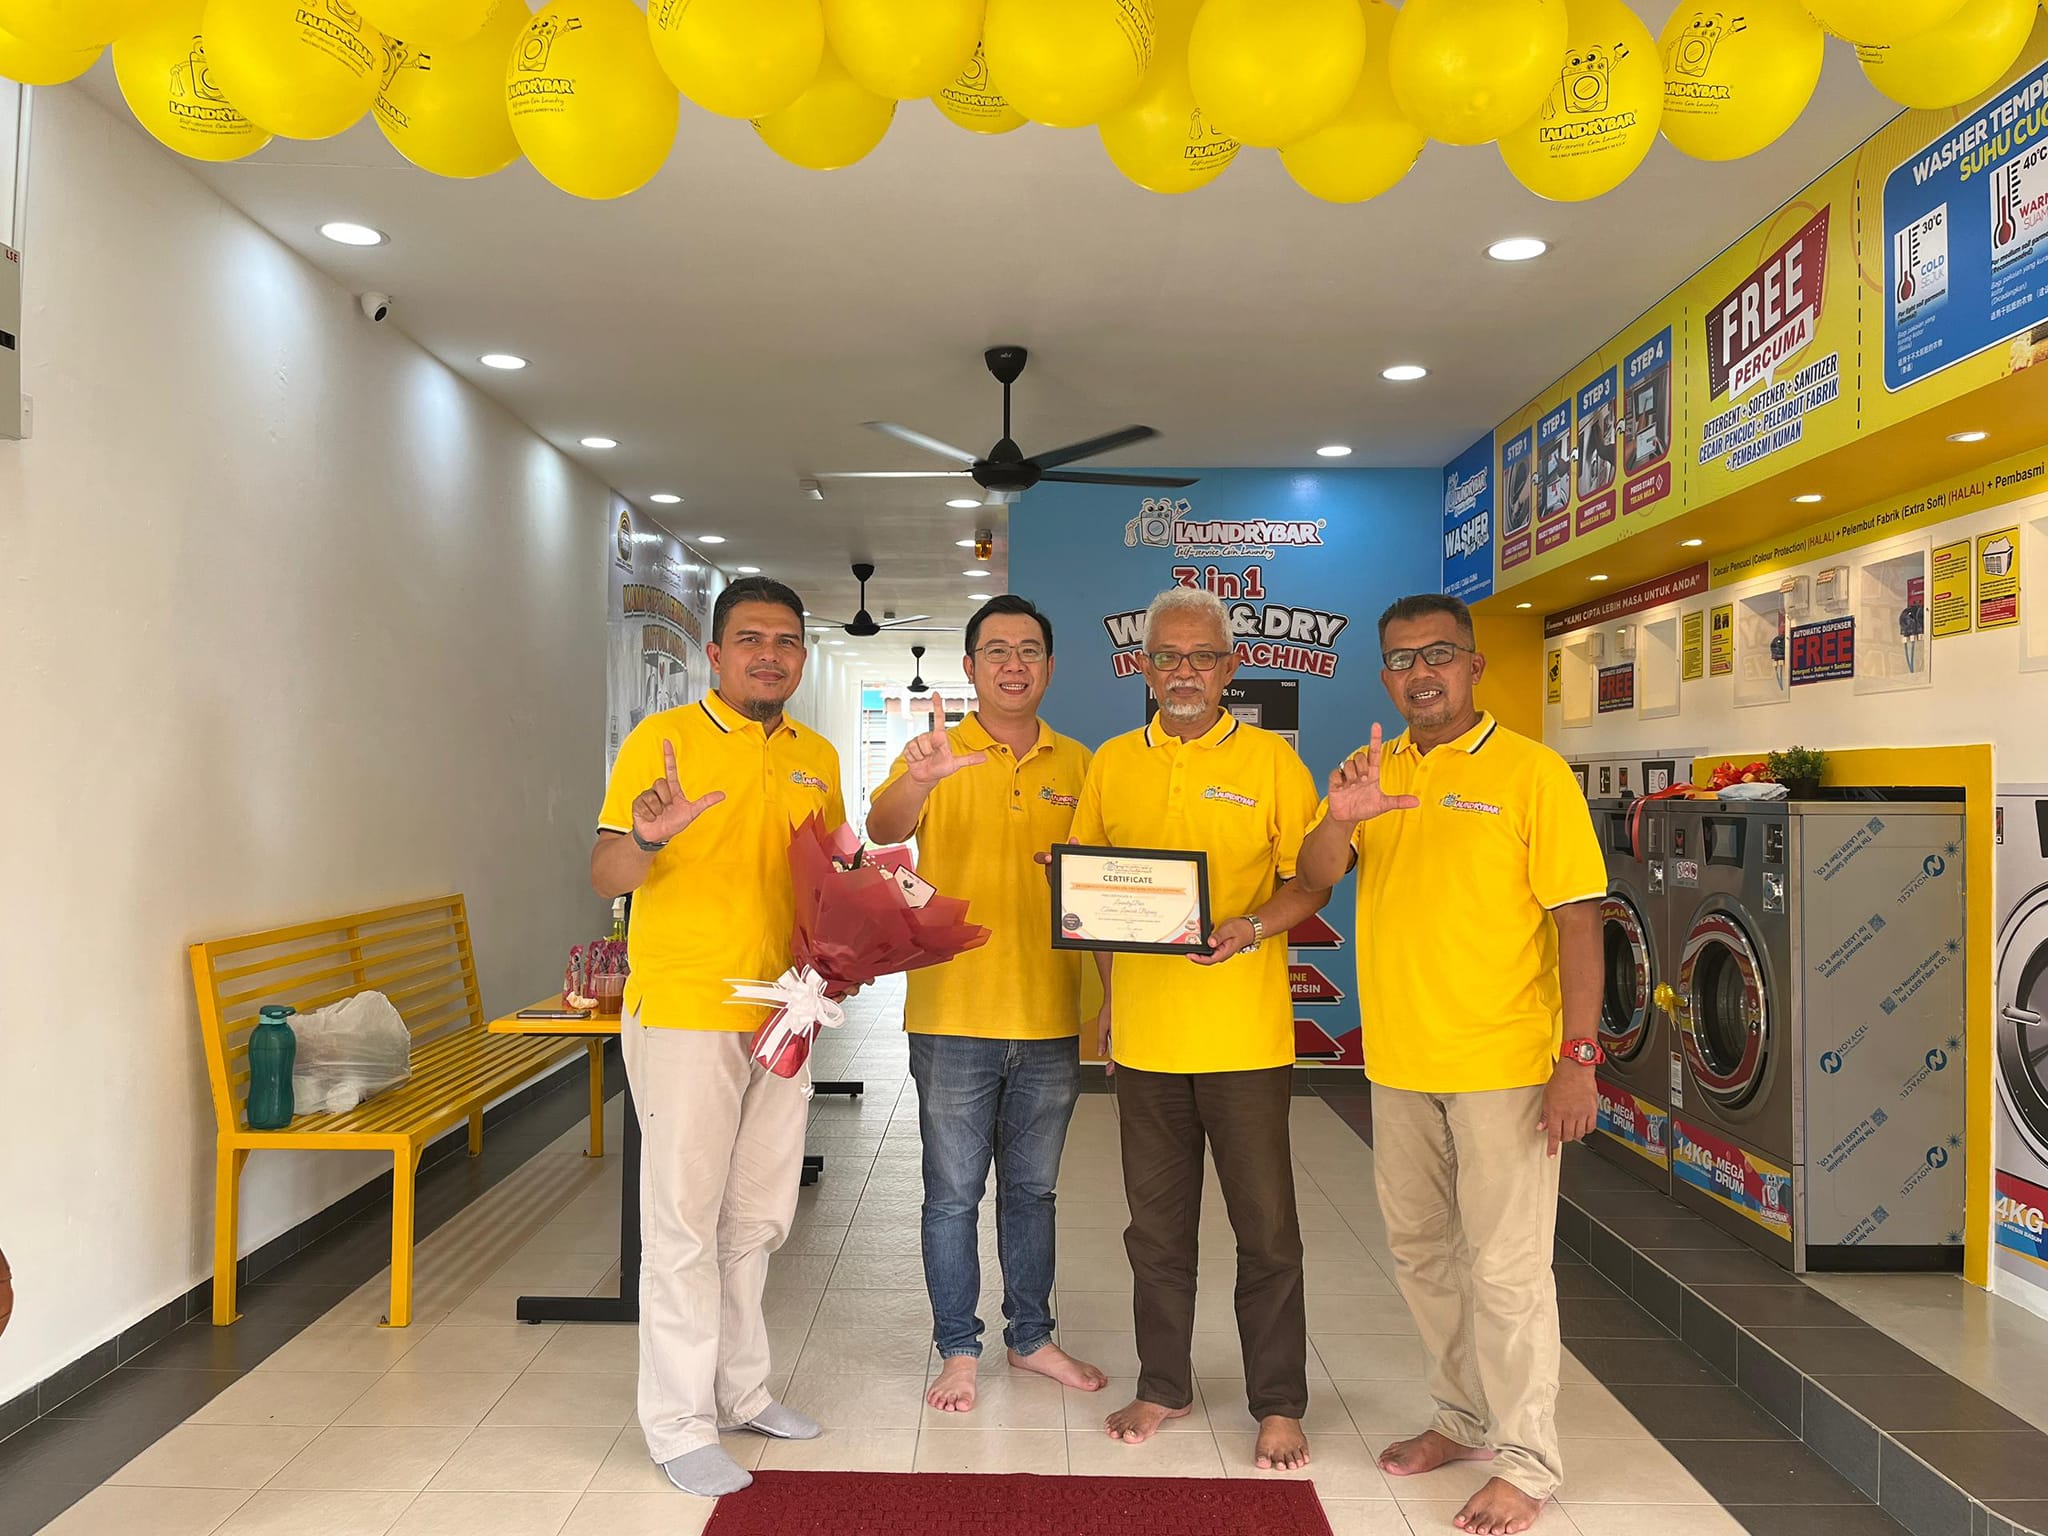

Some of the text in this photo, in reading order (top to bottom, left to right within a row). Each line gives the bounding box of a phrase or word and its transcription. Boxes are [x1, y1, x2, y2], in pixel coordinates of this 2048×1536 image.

[508, 77, 574, 100] UNDRYBAR
[1664, 81, 1730, 99] UNDRYBAR
[1540, 112, 1636, 142] LAUNDRYBAR
[1913, 119, 1988, 186] WASHER
[1960, 128, 2010, 181] SUHU
[1922, 213, 1942, 235] 30°C
[1921, 254, 1945, 276] COLD
[1921, 271, 1945, 288] SEJUK
[1722, 239, 1803, 367] FREE
[1630, 340, 1663, 377] STEP 4
[1734, 319, 1806, 391] PERCUMA
[1583, 378, 1610, 410] STEP 3
[1703, 355, 1837, 440] DETERGENT SOFTENER SANITIZER
[1542, 410, 1566, 438] STEP 2
[1700, 377, 1838, 463] CECAIR PENCUCI PELEMBUT FABRIK
[1508, 437, 1527, 461] STEP 1
[1732, 421, 1801, 470] PEMBASMI KUMAN
[1713, 462, 2045, 576] Cecair Pencuci (Colour Protection) (HALAL) Pelembut Fabrik (Extra Soft) (HALAL) Pembasmi
[1174, 520, 1322, 545] LAUNDRYBAR
[1444, 510, 1489, 560] WASHER
[1175, 546, 1275, 559] Self-service Coin Laundry
[1173, 566, 1265, 599] 3 in 1
[1583, 608, 1600, 620] CIPTA
[1602, 601, 1621, 615] LEBIH
[1622, 595, 1642, 609] MASA
[1644, 584, 1670, 601] UNTUK
[1230, 604, 1347, 648] & DRY
[1793, 620, 1851, 638] AUTOMATIC DISPENSER
[1236, 645, 1338, 677] ACHINE
[1793, 629, 1852, 668] FREE
[1231, 689, 1245, 698] Dry
[1600, 672, 1632, 699] FREE
[1215, 791, 1256, 807] LAUNDRYBAR
[1840, 834, 1858, 853] LASER
[1842, 843, 1863, 864] Novacel
[1103, 875, 1153, 884] CERTIFICATE
[1823, 860, 1845, 882] Solution
[1896, 873, 1928, 905] NOVACEL
[1841, 932, 1859, 949] LASER
[1843, 940, 1864, 961] Novacel
[1824, 957, 1846, 979] Solution
[1900, 967, 1922, 988] Novacel
[1918, 948, 1941, 970] Solution
[1904, 978, 1923, 996] LASER
[1835, 1023, 1868, 1054] NOVACEL
[1899, 1067, 1931, 1099] NOVACEL
[1597, 1093, 1611, 1116] KG
[1614, 1102, 1634, 1122] MEGA
[1613, 1114, 1634, 1133] DRUM
[1843, 1125, 1861, 1144] LASER
[1678, 1137, 1712, 1171] 14KG
[1845, 1134, 1866, 1155] Novacel
[1716, 1156, 1744, 1182] MEGA
[1825, 1151, 1848, 1174] Solution
[1715, 1170, 1744, 1195] DRUM
[1899, 1164, 1932, 1196] NOVACEL
[1995, 1196, 2044, 1235] 4KG
